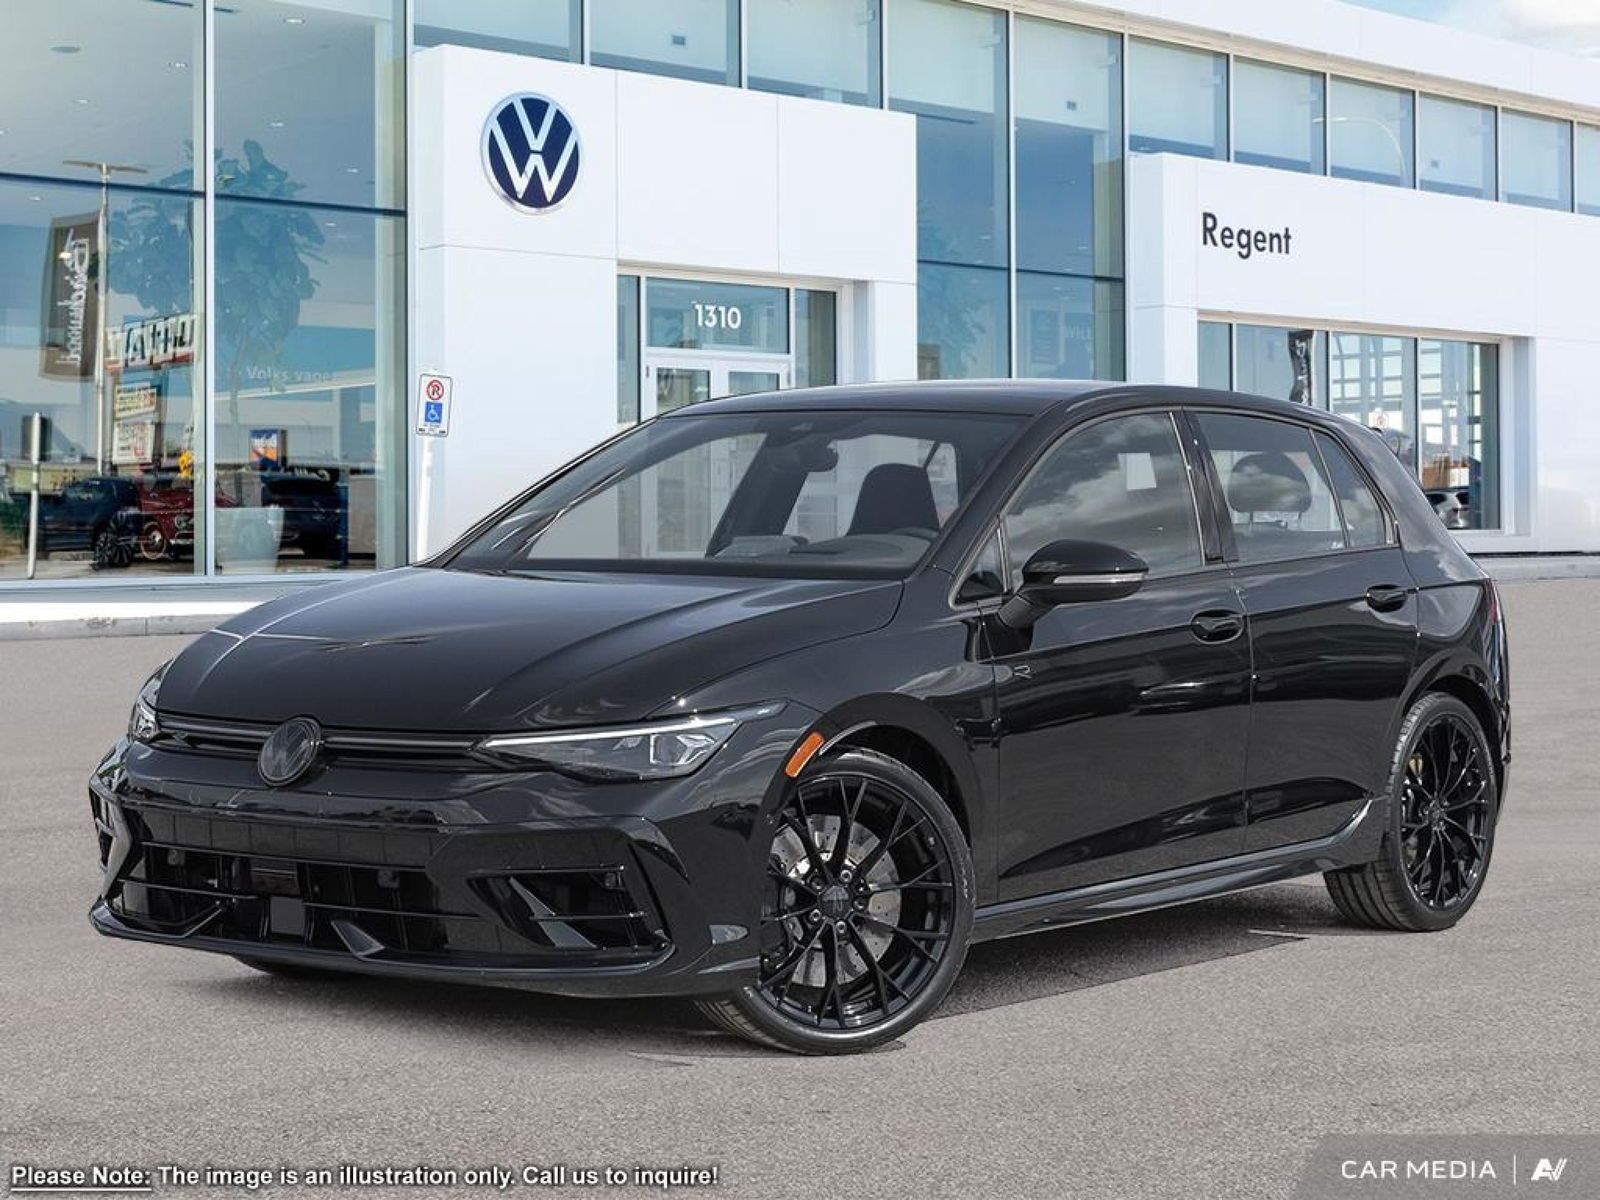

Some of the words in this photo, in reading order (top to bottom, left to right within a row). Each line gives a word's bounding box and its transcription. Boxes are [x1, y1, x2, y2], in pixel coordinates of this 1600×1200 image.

[480, 91, 581, 214] VW
[1202, 211, 1292, 260] Regent
[694, 303, 742, 329] 1310
